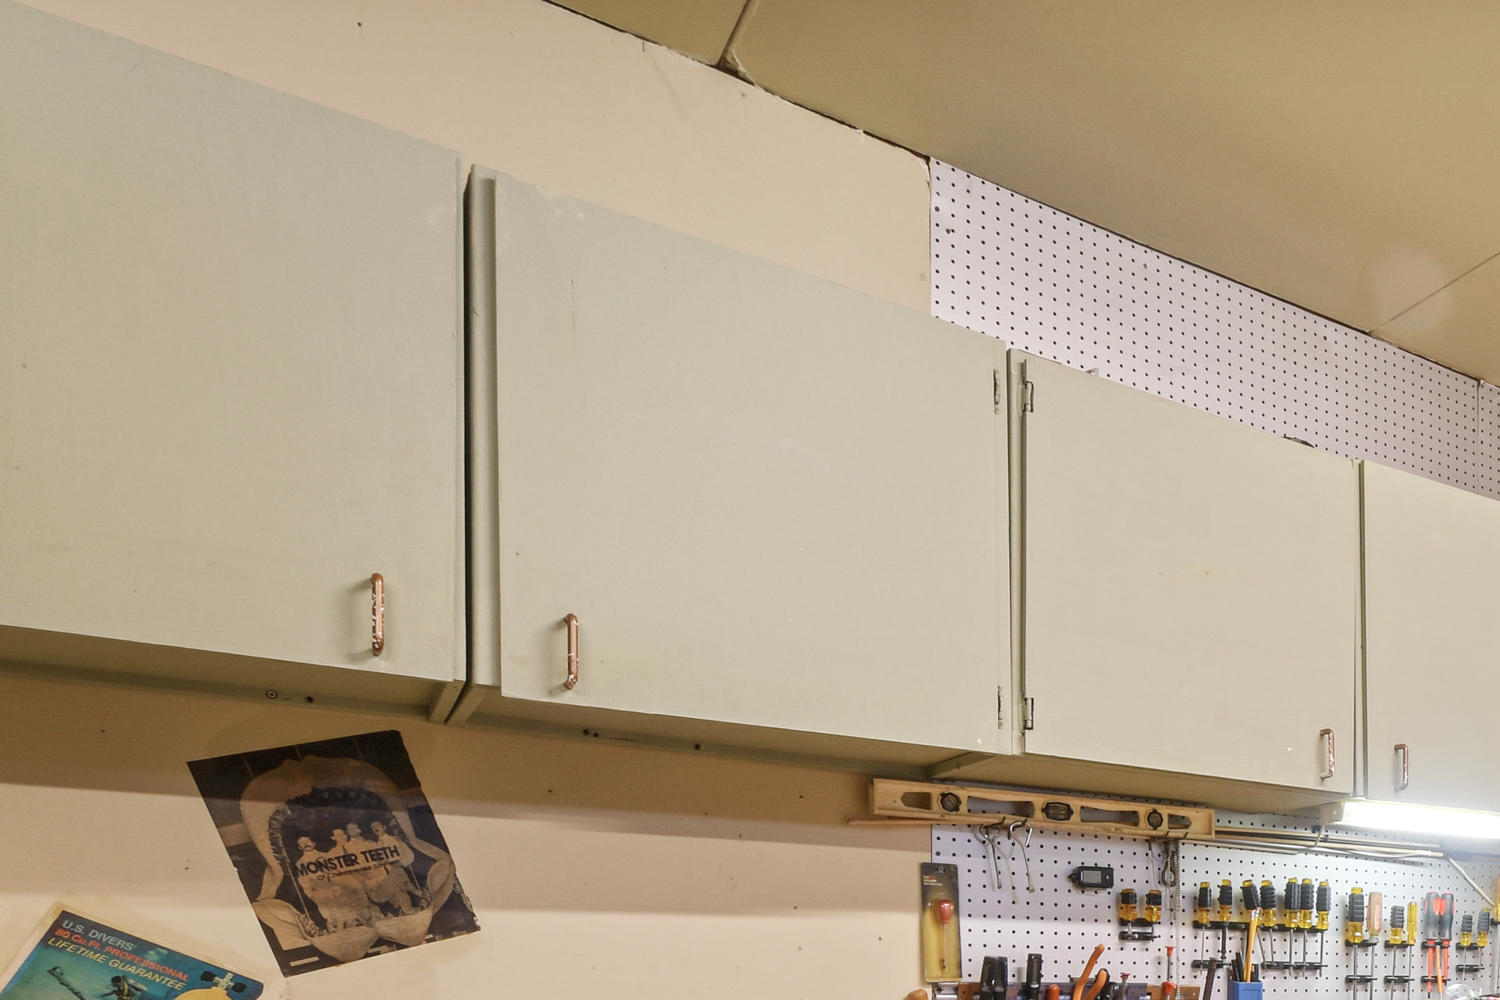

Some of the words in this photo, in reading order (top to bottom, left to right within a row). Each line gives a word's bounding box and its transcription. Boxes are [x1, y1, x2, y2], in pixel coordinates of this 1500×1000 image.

[292, 853, 360, 877] MONSTER
[360, 845, 400, 864] TEETH
[62, 920, 85, 935] U.S.
[47, 937, 109, 964] LIFETIME
[109, 959, 187, 991] GUARANTEE
[55, 928, 71, 939] 80
[104, 945, 189, 982] PROFESSIONAL
